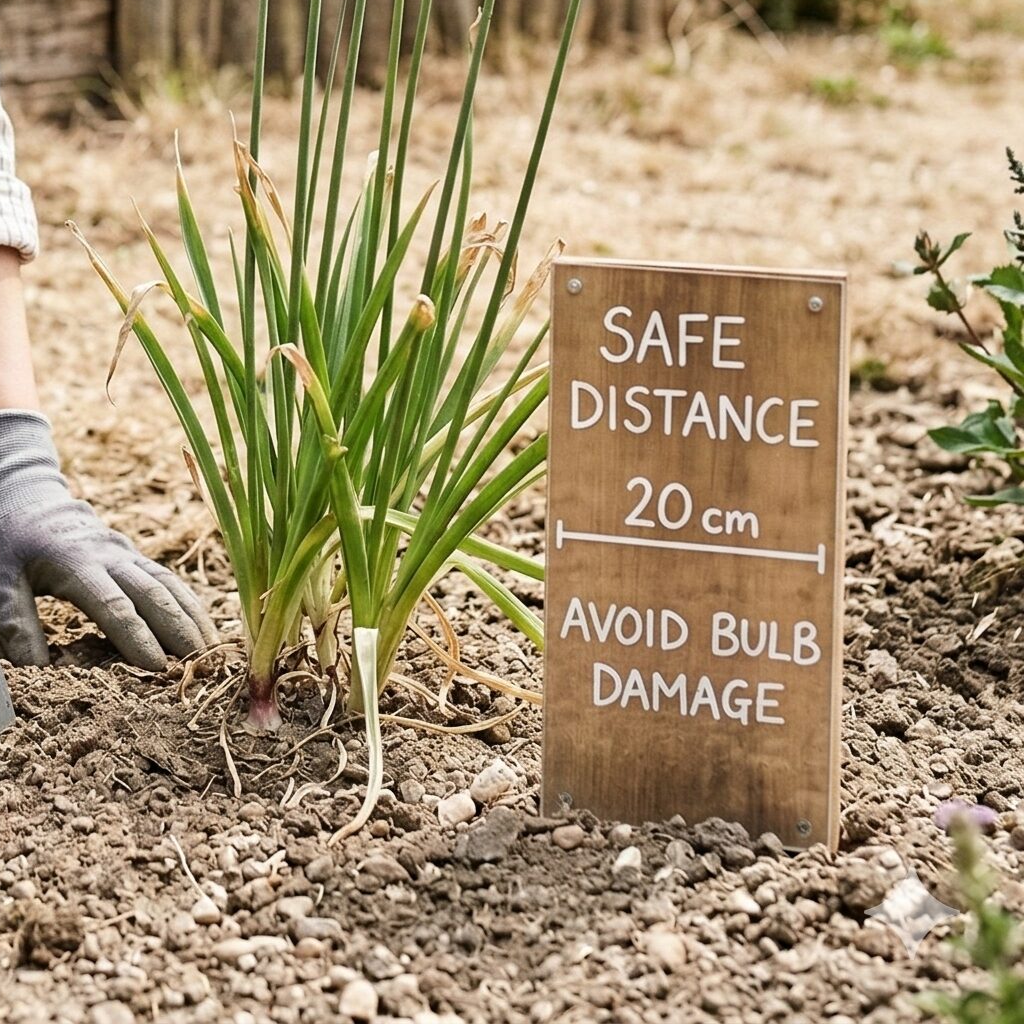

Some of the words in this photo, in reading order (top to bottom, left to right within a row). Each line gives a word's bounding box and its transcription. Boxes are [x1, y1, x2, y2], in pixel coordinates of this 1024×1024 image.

[600, 306, 745, 369] SAFE
[571, 380, 819, 447] DISTANCE
[624, 477, 692, 529] 20
[702, 506, 759, 538] cm
[560, 597, 689, 651] AVOID
[712, 612, 821, 665] BULB
[593, 662, 785, 725] DAMAGE
